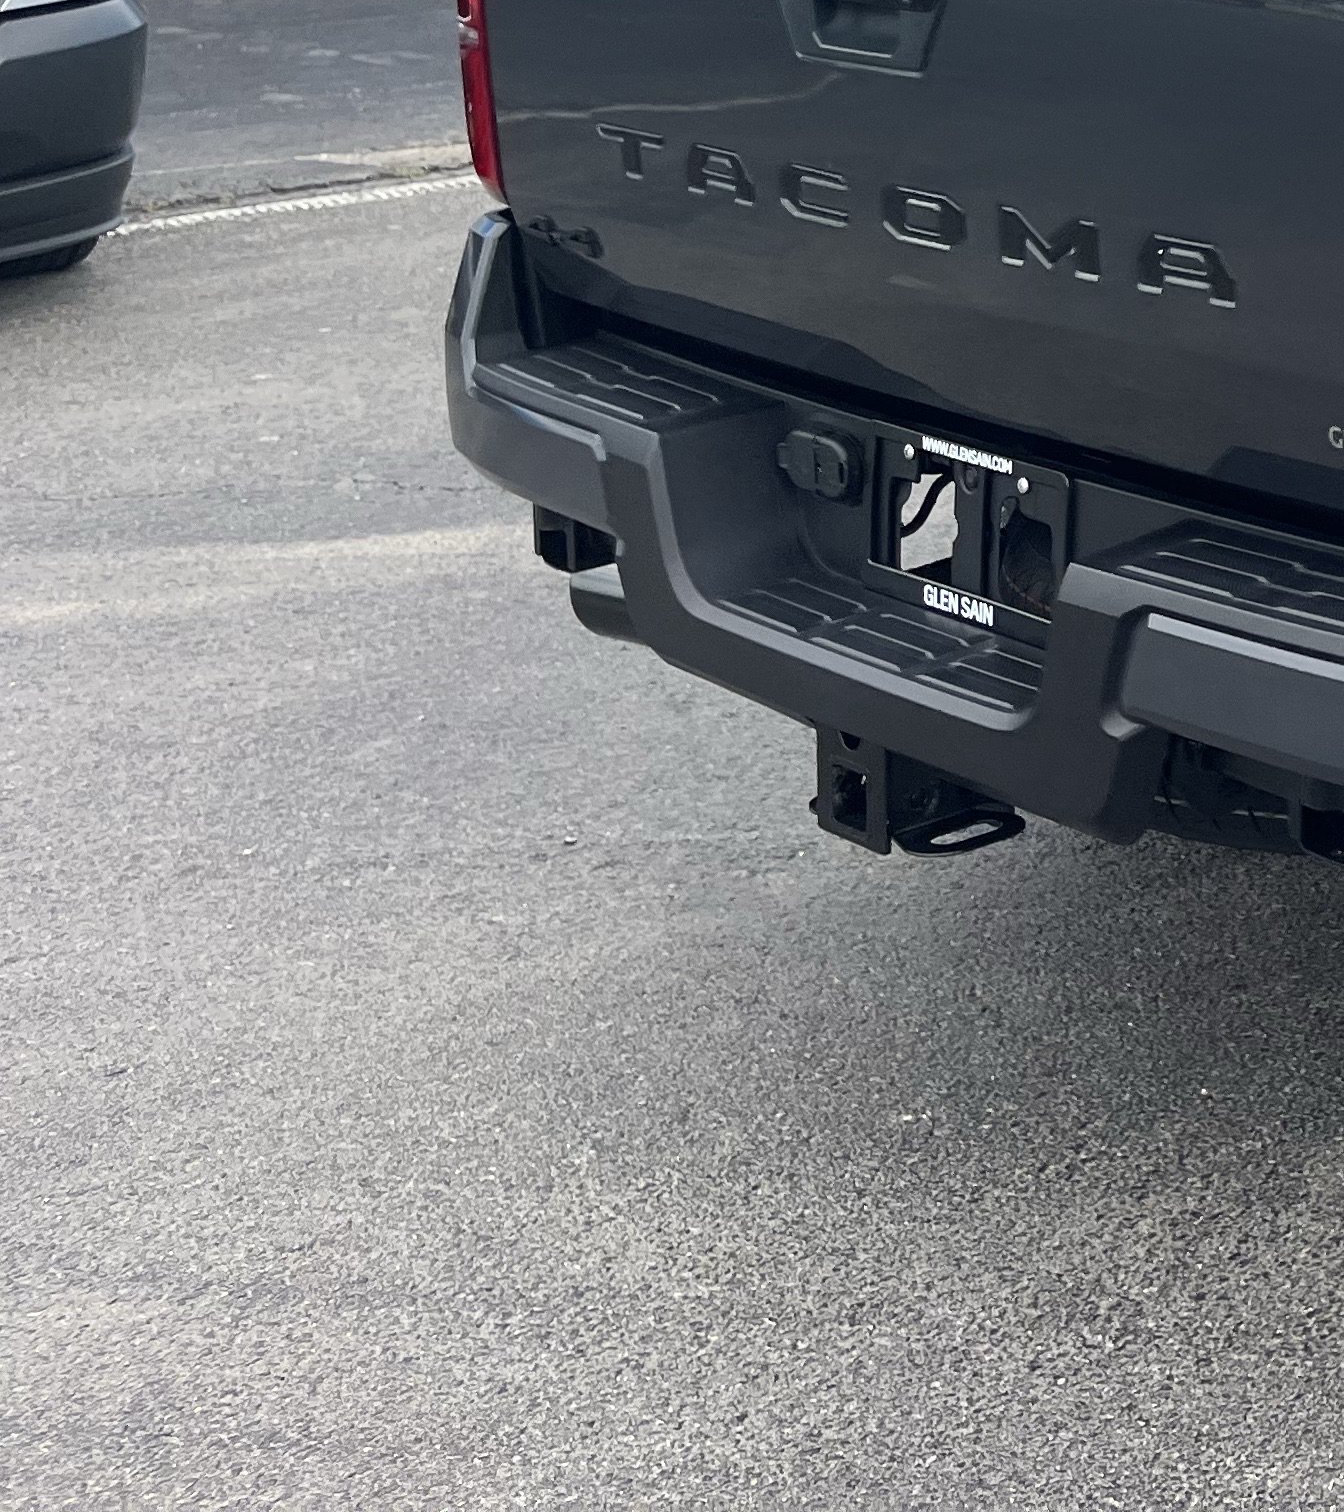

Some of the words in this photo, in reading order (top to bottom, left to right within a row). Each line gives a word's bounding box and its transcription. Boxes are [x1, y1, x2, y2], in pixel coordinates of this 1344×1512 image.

[596, 122, 1237, 309] TACOMA
[922, 435, 1013, 475] WWW.GLENSAIN.COM
[923, 583, 959, 615] GLEN
[960, 595, 994, 627] SAIN
